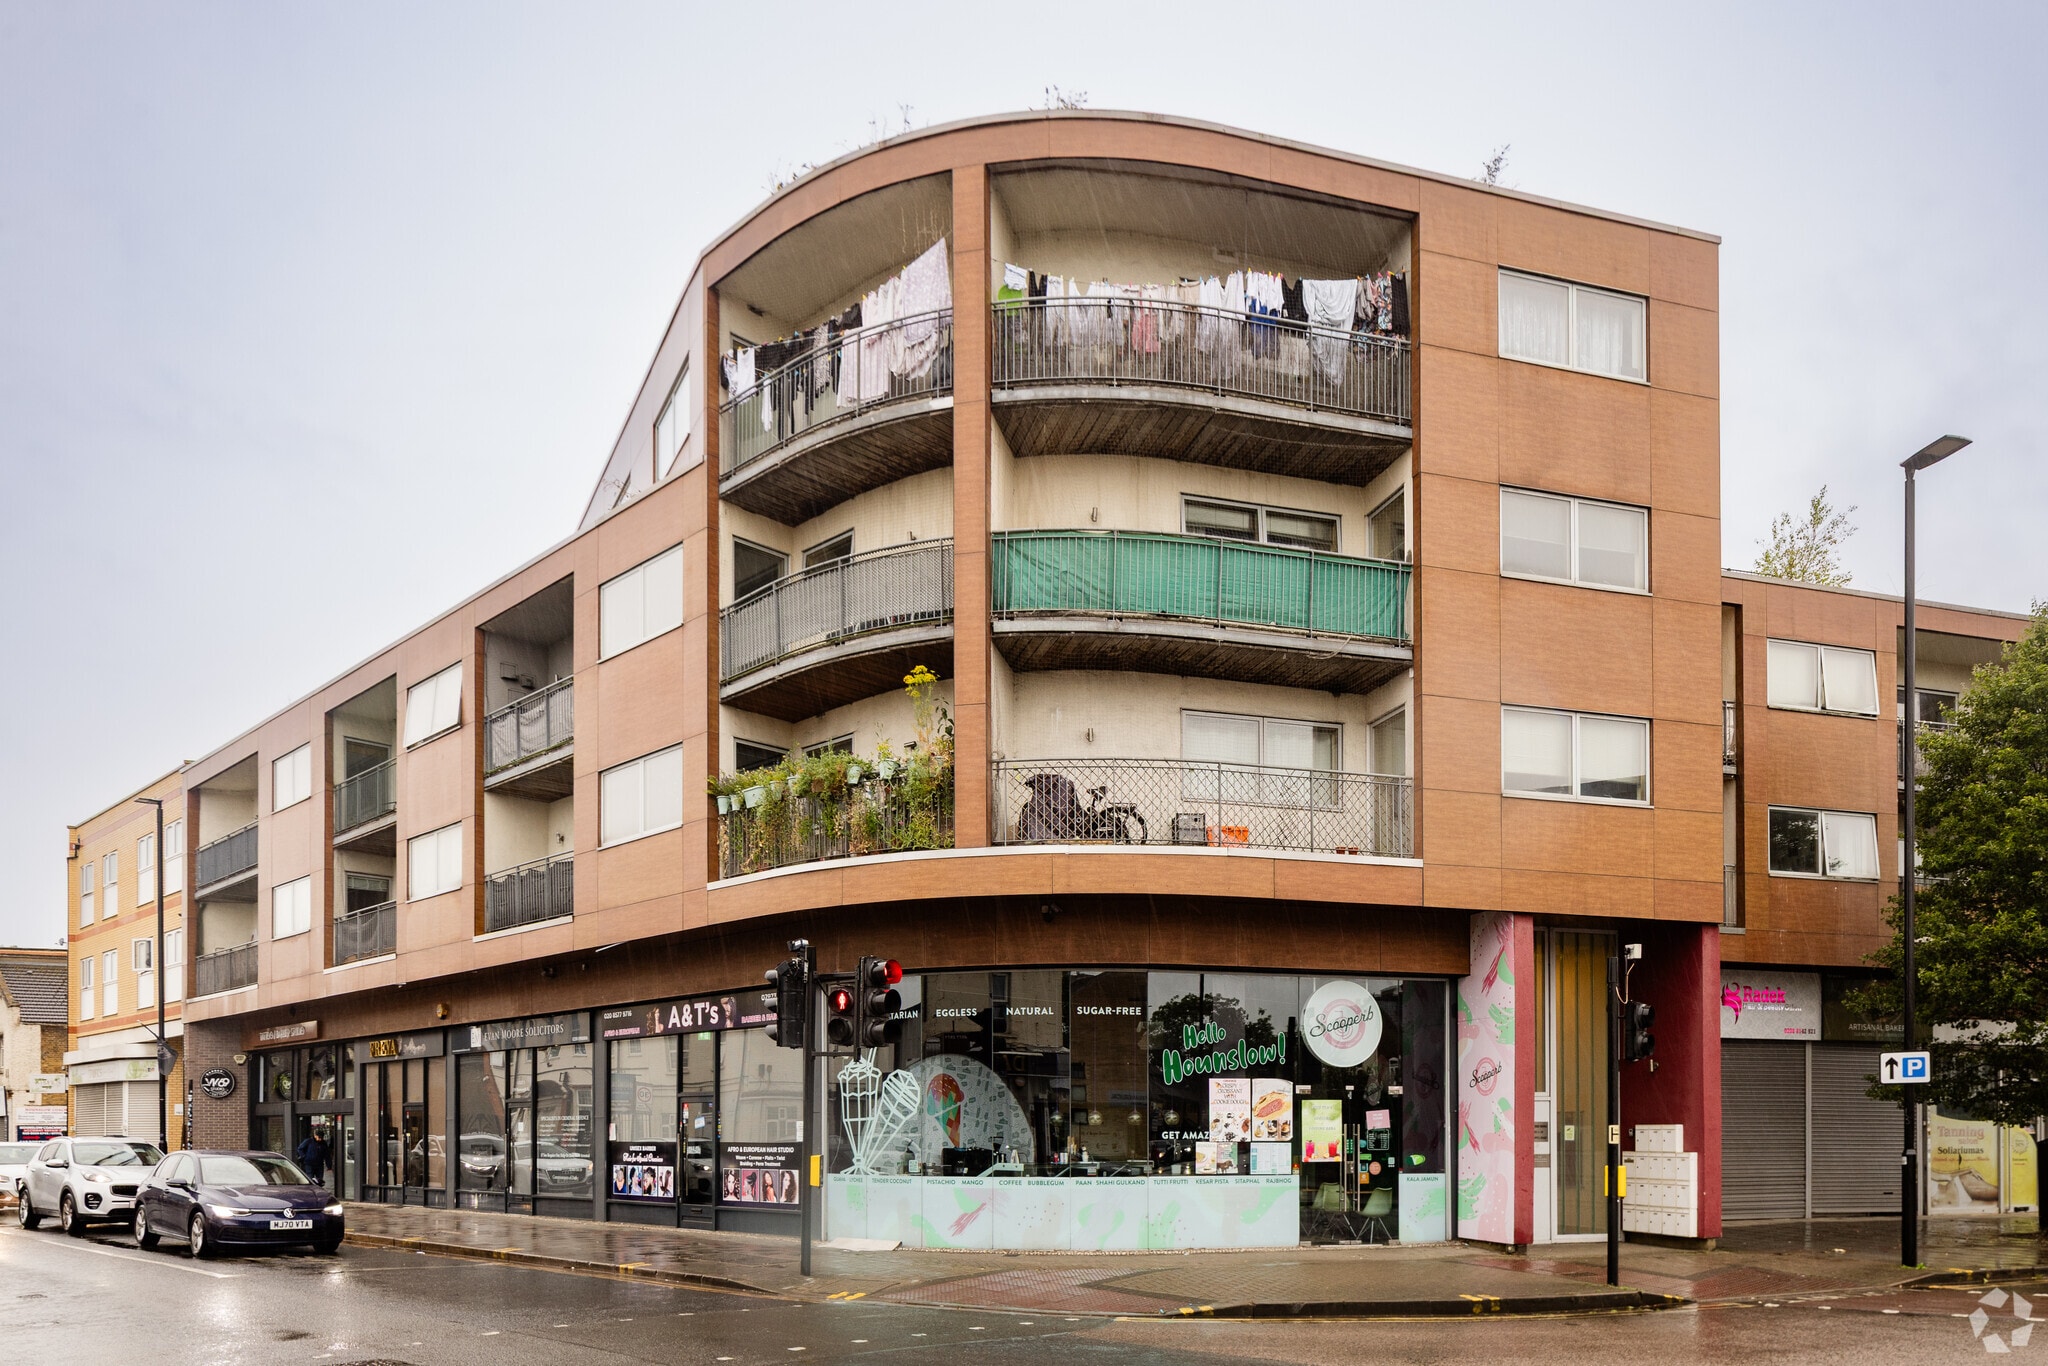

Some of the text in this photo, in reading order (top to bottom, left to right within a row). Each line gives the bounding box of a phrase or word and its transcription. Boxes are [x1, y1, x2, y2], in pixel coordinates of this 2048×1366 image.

[1742, 985, 1787, 1004] Radek
[667, 1001, 720, 1029] A&T's
[935, 1007, 978, 1018] EGGLESS
[1005, 1006, 1055, 1016] NATURAL
[1076, 1005, 1143, 1016] SUGAR-FREE
[1309, 1004, 1375, 1039] Scooperb
[1848, 1023, 1884, 1031] ARTISANAL
[484, 1032, 500, 1041] EVAN
[501, 1029, 525, 1040] MOORE
[525, 1023, 564, 1037] SOLICITORS
[1183, 1020, 1227, 1051] Hello
[369, 1039, 397, 1058] FREYA
[1162, 1031, 1287, 1086] Hounslow!
[1907, 1059, 1923, 1077] P
[1161, 1131, 1210, 1140] GET AMAZ
[1936, 1126, 1985, 1139] Tanning
[295, 1220, 310, 1228] VTA
